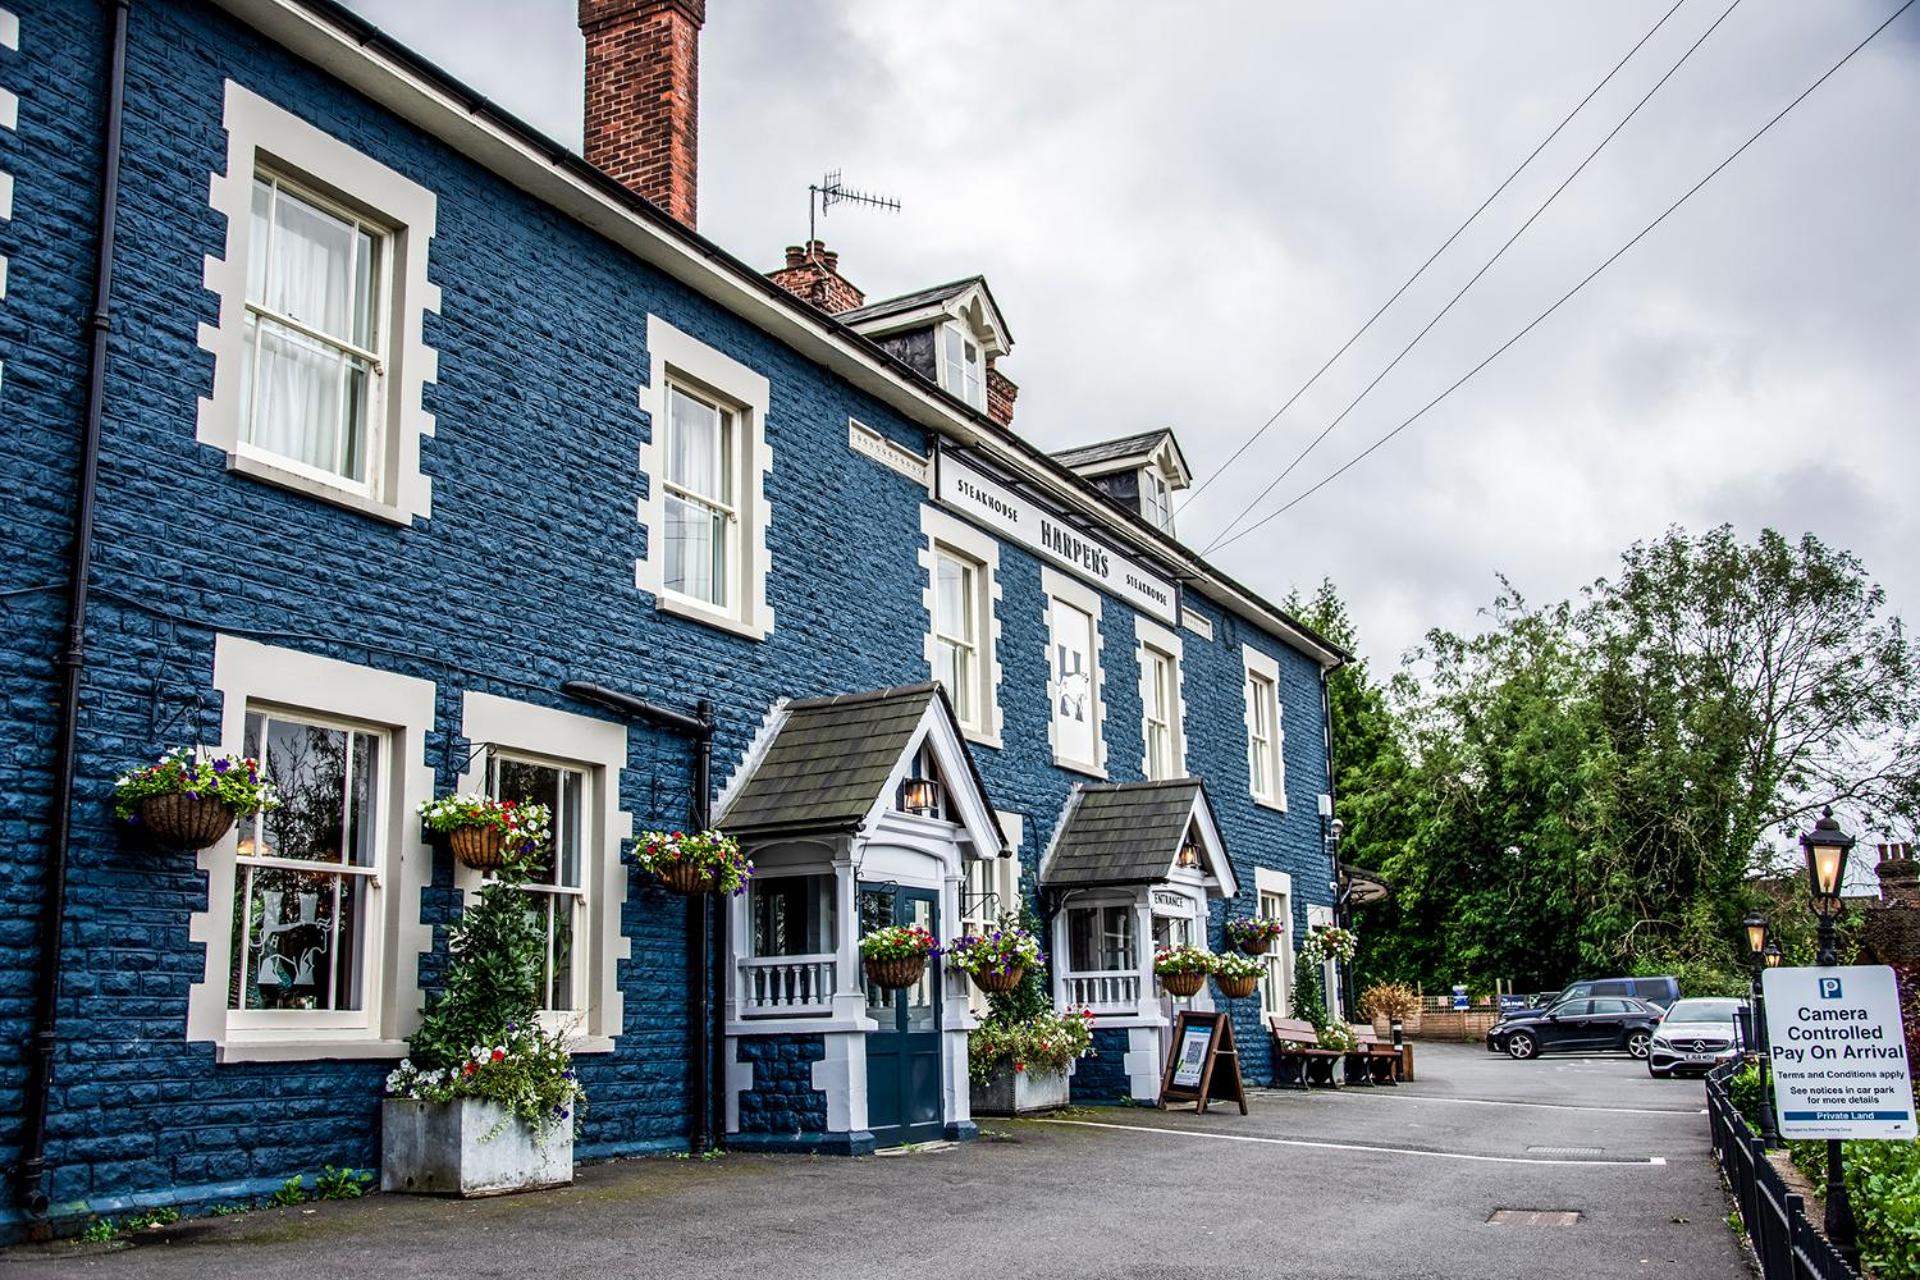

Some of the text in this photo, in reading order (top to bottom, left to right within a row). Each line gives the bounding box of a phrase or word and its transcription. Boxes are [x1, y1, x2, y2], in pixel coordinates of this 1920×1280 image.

[957, 479, 1018, 523] STEAKHOUSE
[1040, 519, 1109, 578] HARPER'S
[1125, 574, 1168, 606] STEAKHOUSE
[1154, 893, 1184, 908] ENTRANCE
[1798, 1007, 1868, 1021] Camera
[1787, 1025, 1883, 1040] Controlled
[1772, 1044, 1904, 1063] Pay On Arrival
[1777, 1070, 1905, 1080] Terms and Conditions apply
[1790, 1086, 1808, 1095] See
[1809, 1086, 1843, 1094] notices
[1845, 1086, 1855, 1094] in
[1873, 1086, 1895, 1096] park
[1807, 1096, 1820, 1104] for
[1848, 1096, 1880, 1104] details
[1816, 1111, 1875, 1120] Private Land
